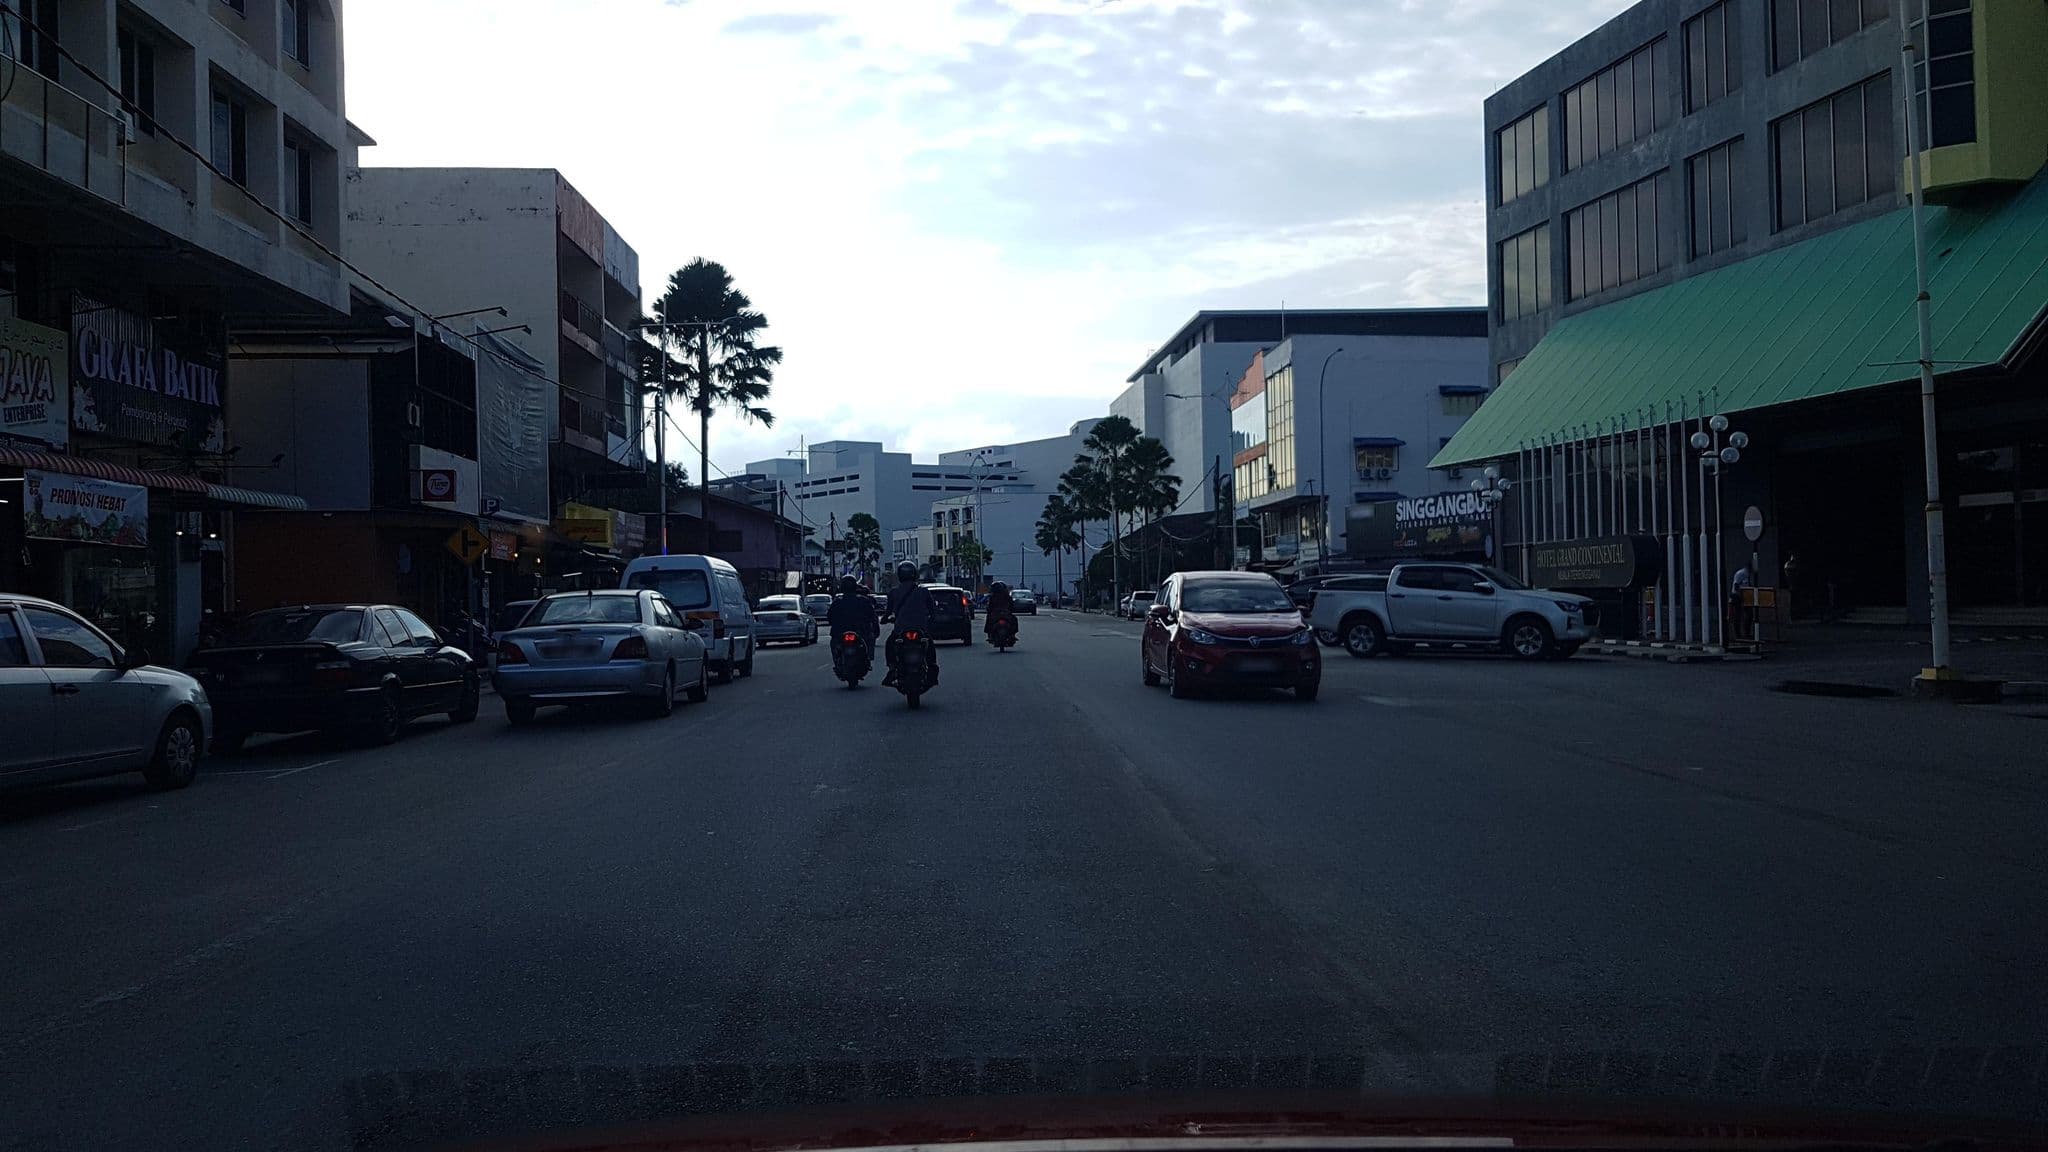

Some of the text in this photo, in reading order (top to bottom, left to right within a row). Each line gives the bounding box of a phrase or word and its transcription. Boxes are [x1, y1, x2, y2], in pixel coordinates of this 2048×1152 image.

[161, 347, 220, 407] BATIK
[3, 403, 46, 423] ENTERPRISE
[96, 494, 127, 512] HEBAT
[1537, 543, 1624, 568] HOTEL GRAND CONTINENTAL
